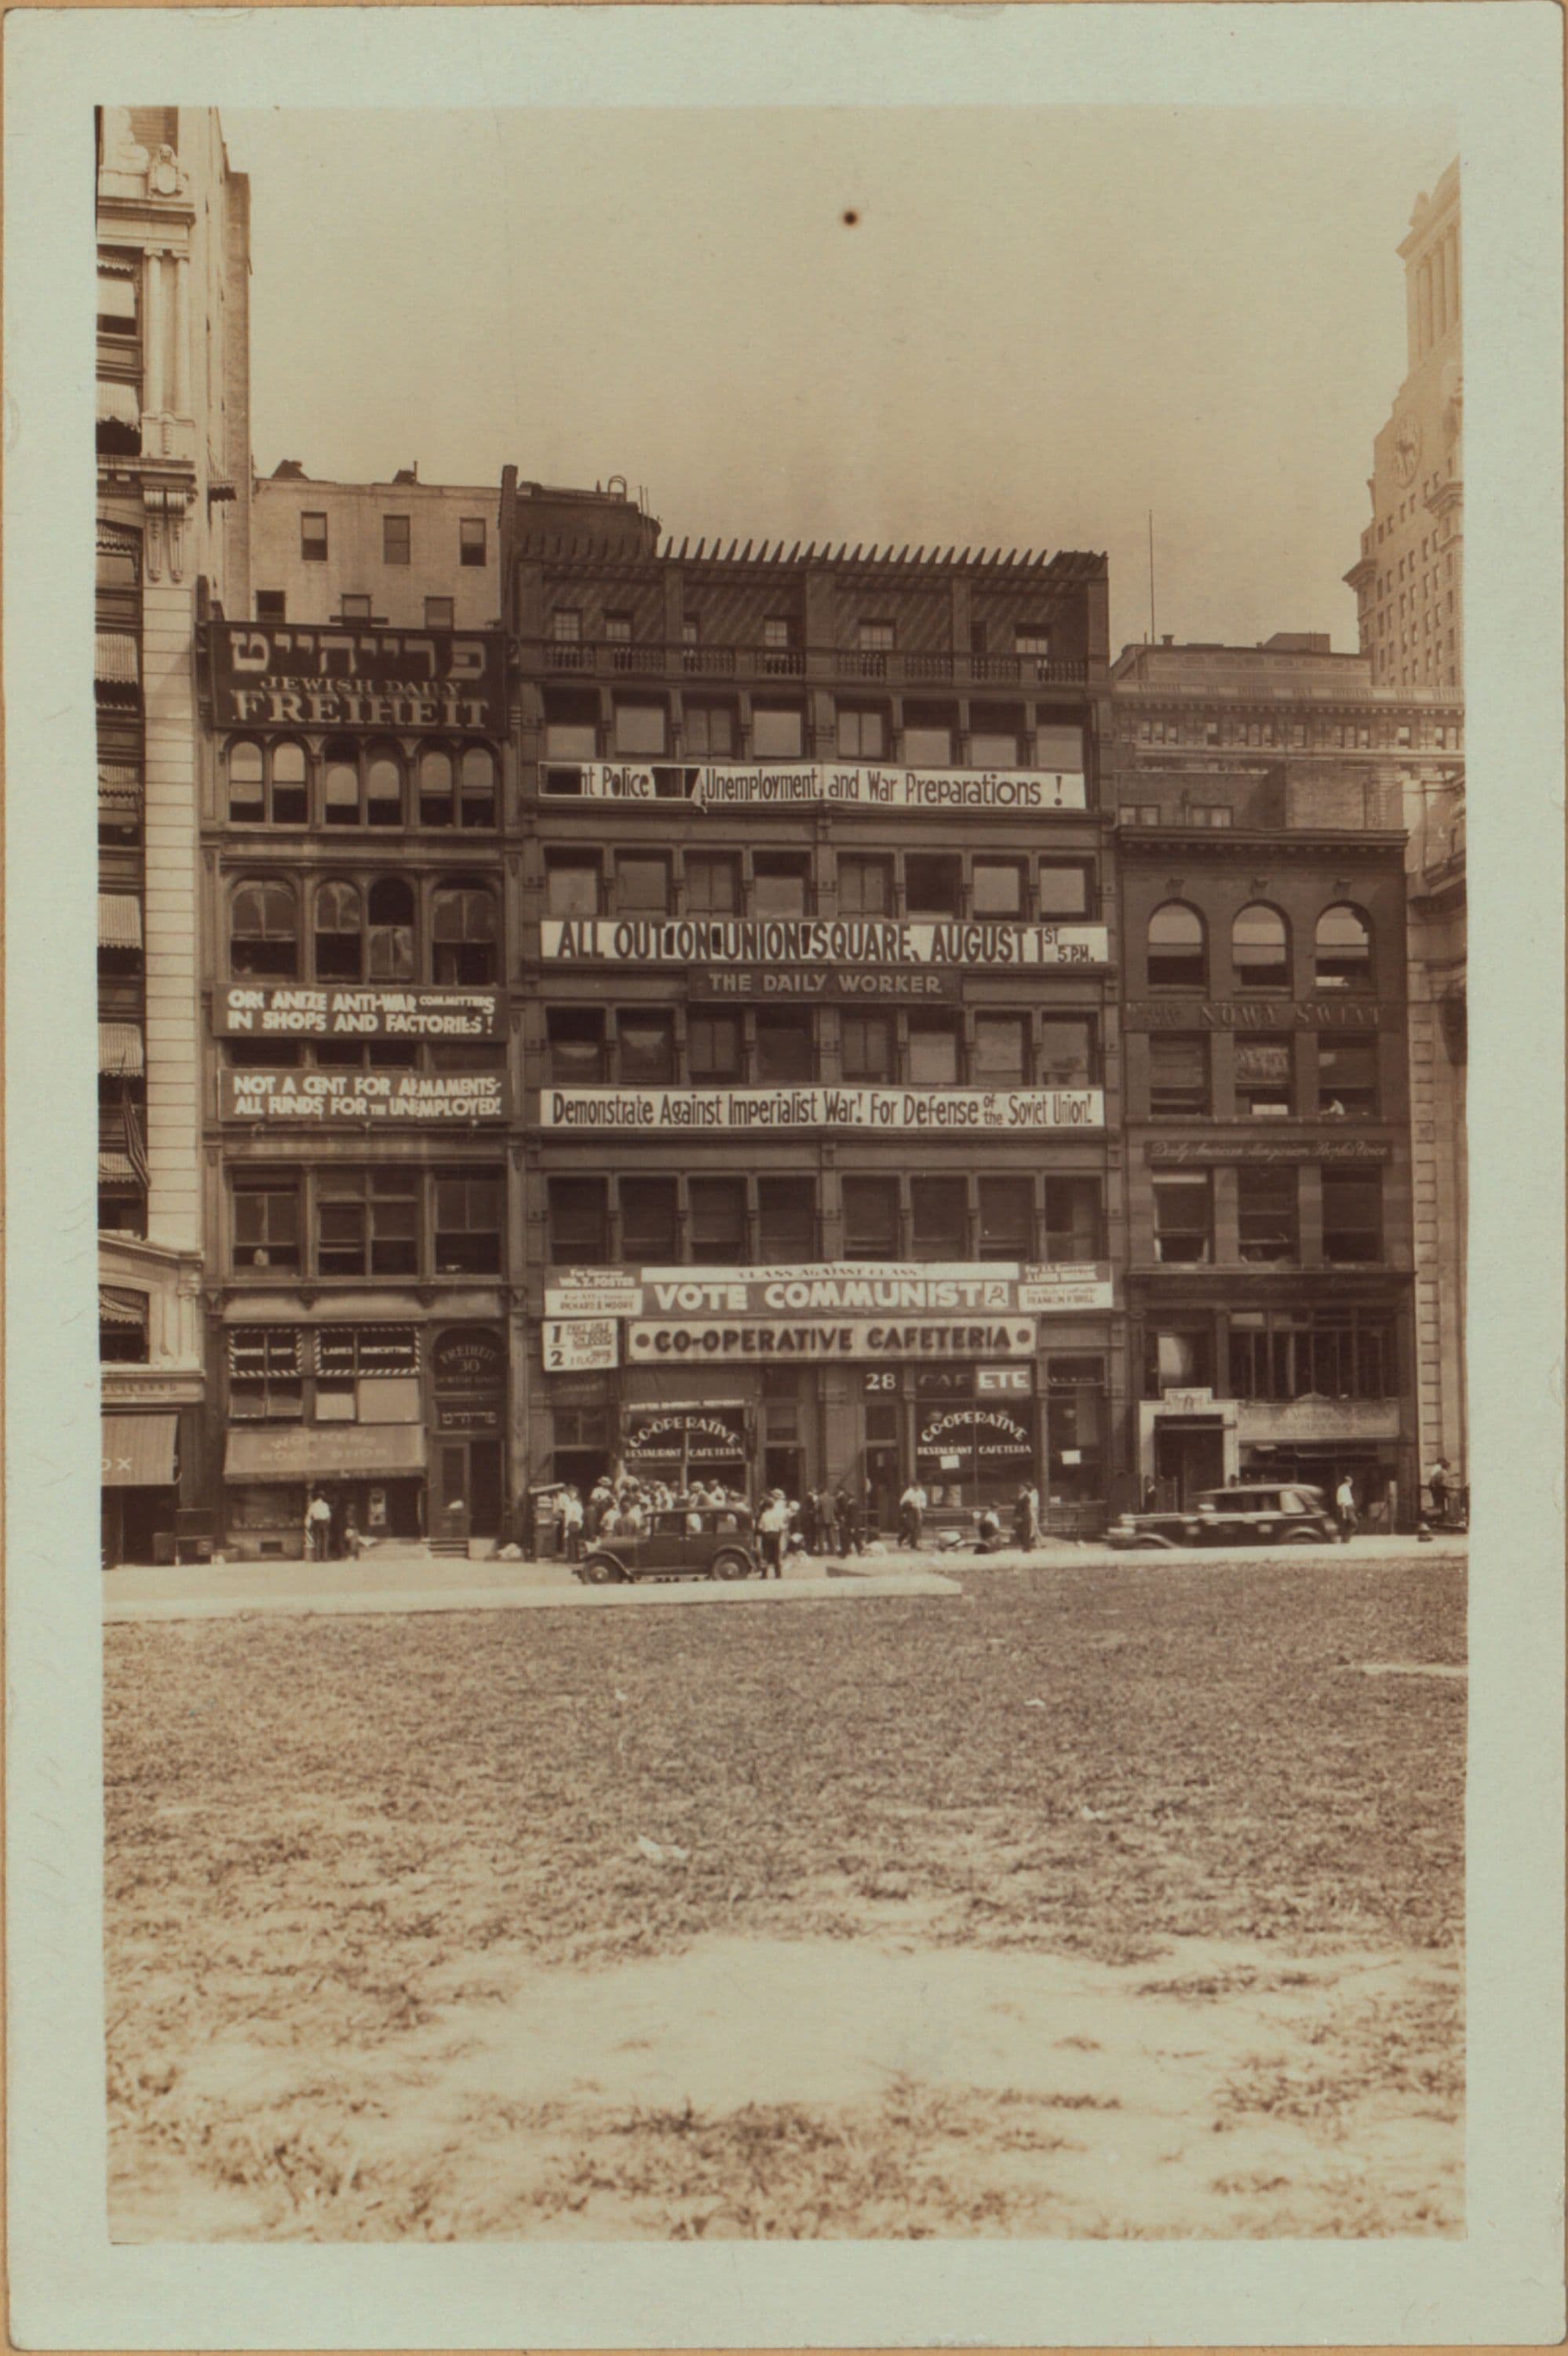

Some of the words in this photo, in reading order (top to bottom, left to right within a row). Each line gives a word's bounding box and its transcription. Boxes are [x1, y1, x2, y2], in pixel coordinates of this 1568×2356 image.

[260, 677, 374, 695] JEWISH
[385, 680, 461, 698] DAILY
[230, 689, 490, 728] FREIHEIT
[602, 767, 650, 797] Police
[706, 767, 823, 800] Unemployment,
[828, 769, 859, 799] and
[867, 770, 898, 803] War
[906, 772, 1041, 805] Preparations
[558, 921, 604, 959] ALL
[614, 921, 668, 960] OUT
[676, 922, 707, 960] ON
[723, 922, 800, 961] UNION
[812, 922, 921, 962] SQUARE,
[930, 925, 1029, 963] AUGUST
[709, 973, 753, 993] THE
[763, 974, 825, 993] DAILY
[838, 975, 943, 994] WORKER
[332, 992, 417, 1013] ANTI-WAR
[1198, 1003, 1277, 1026] NOWY
[227, 1010, 253, 1030] IN
[262, 1011, 327, 1032] SHOPS
[334, 1013, 378, 1033] AND
[233, 1075, 276, 1095] NOT
[282, 1076, 297, 1095] A
[303, 1076, 348, 1096] CENT
[354, 1077, 391, 1096] FOR
[235, 1096, 264, 1115] ALL
[268, 1096, 325, 1116] FUNDS
[330, 1097, 367, 1116] FOR
[552, 1092, 655, 1125] Demonstrate
[659, 1093, 723, 1125] Against
[727, 1092, 819, 1125] Imperialist
[823, 1090, 862, 1124] War!
[870, 1093, 898, 1125] For
[903, 1094, 979, 1125] Defense
[983, 1092, 997, 1108] of
[1008, 1094, 1048, 1126] Soviet
[983, 1110, 1004, 1126] the
[654, 1284, 748, 1311] VOTE
[764, 1280, 978, 1310] COMMUNIST
[655, 1327, 854, 1353] CO-OPERATIVE
[866, 1326, 1012, 1350] CAFETERIA
[439, 1344, 496, 1365] FREIHEIT
[866, 1373, 897, 1391] 28
[629, 1416, 740, 1448] CO-OPERATIVE
[921, 1410, 1027, 1442] CO-OPERATIVE
[625, 1448, 682, 1458] RESTAURANT
[689, 1447, 744, 1457] CAFETERIA
[917, 1445, 972, 1456] RESTAURANT
[979, 1443, 1032, 1455] CAFETERIA
